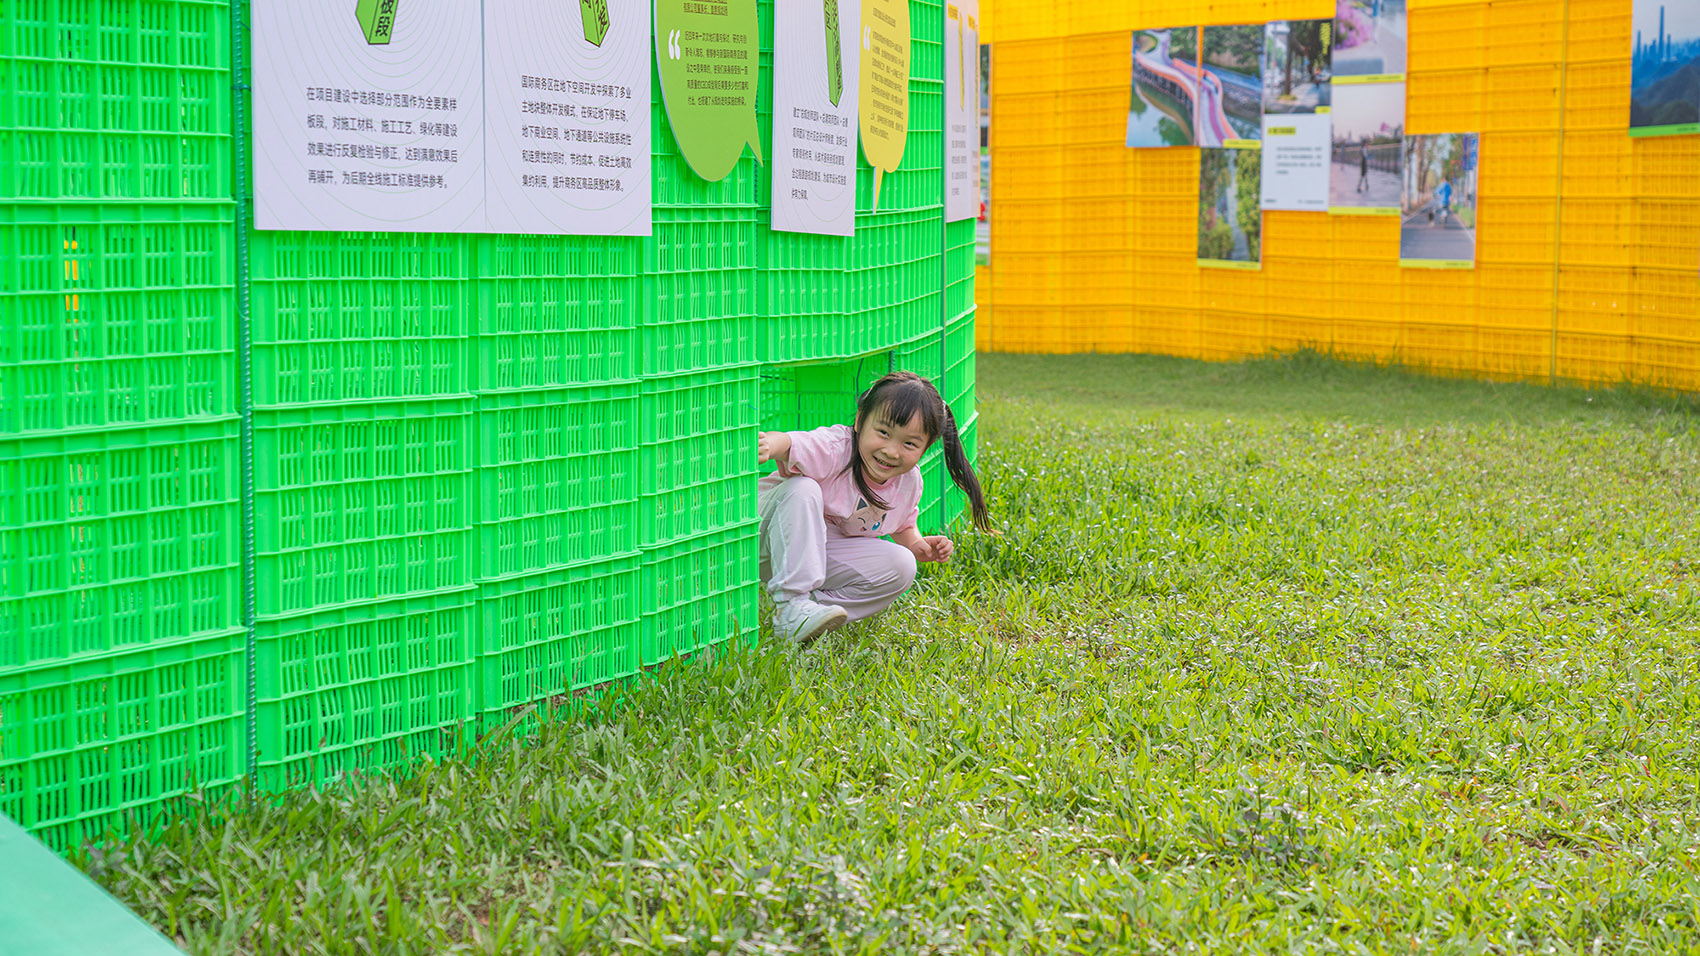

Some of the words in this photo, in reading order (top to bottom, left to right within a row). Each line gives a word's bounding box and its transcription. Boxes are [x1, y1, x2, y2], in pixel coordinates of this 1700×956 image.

[522, 75, 631, 99] 国际商务区在地下空间开发中探索了多业
[306, 87, 457, 111] 在项目建设中选择部分范围作为全要素样
[307, 114, 458, 137] 板段，对施工材料、施工工艺、绿化等建设
[307, 142, 458, 163] 效果进行反复检验与修正，达到满意效果后
[308, 169, 448, 189] 再铺开，为后期全线施工标准提供参考。
